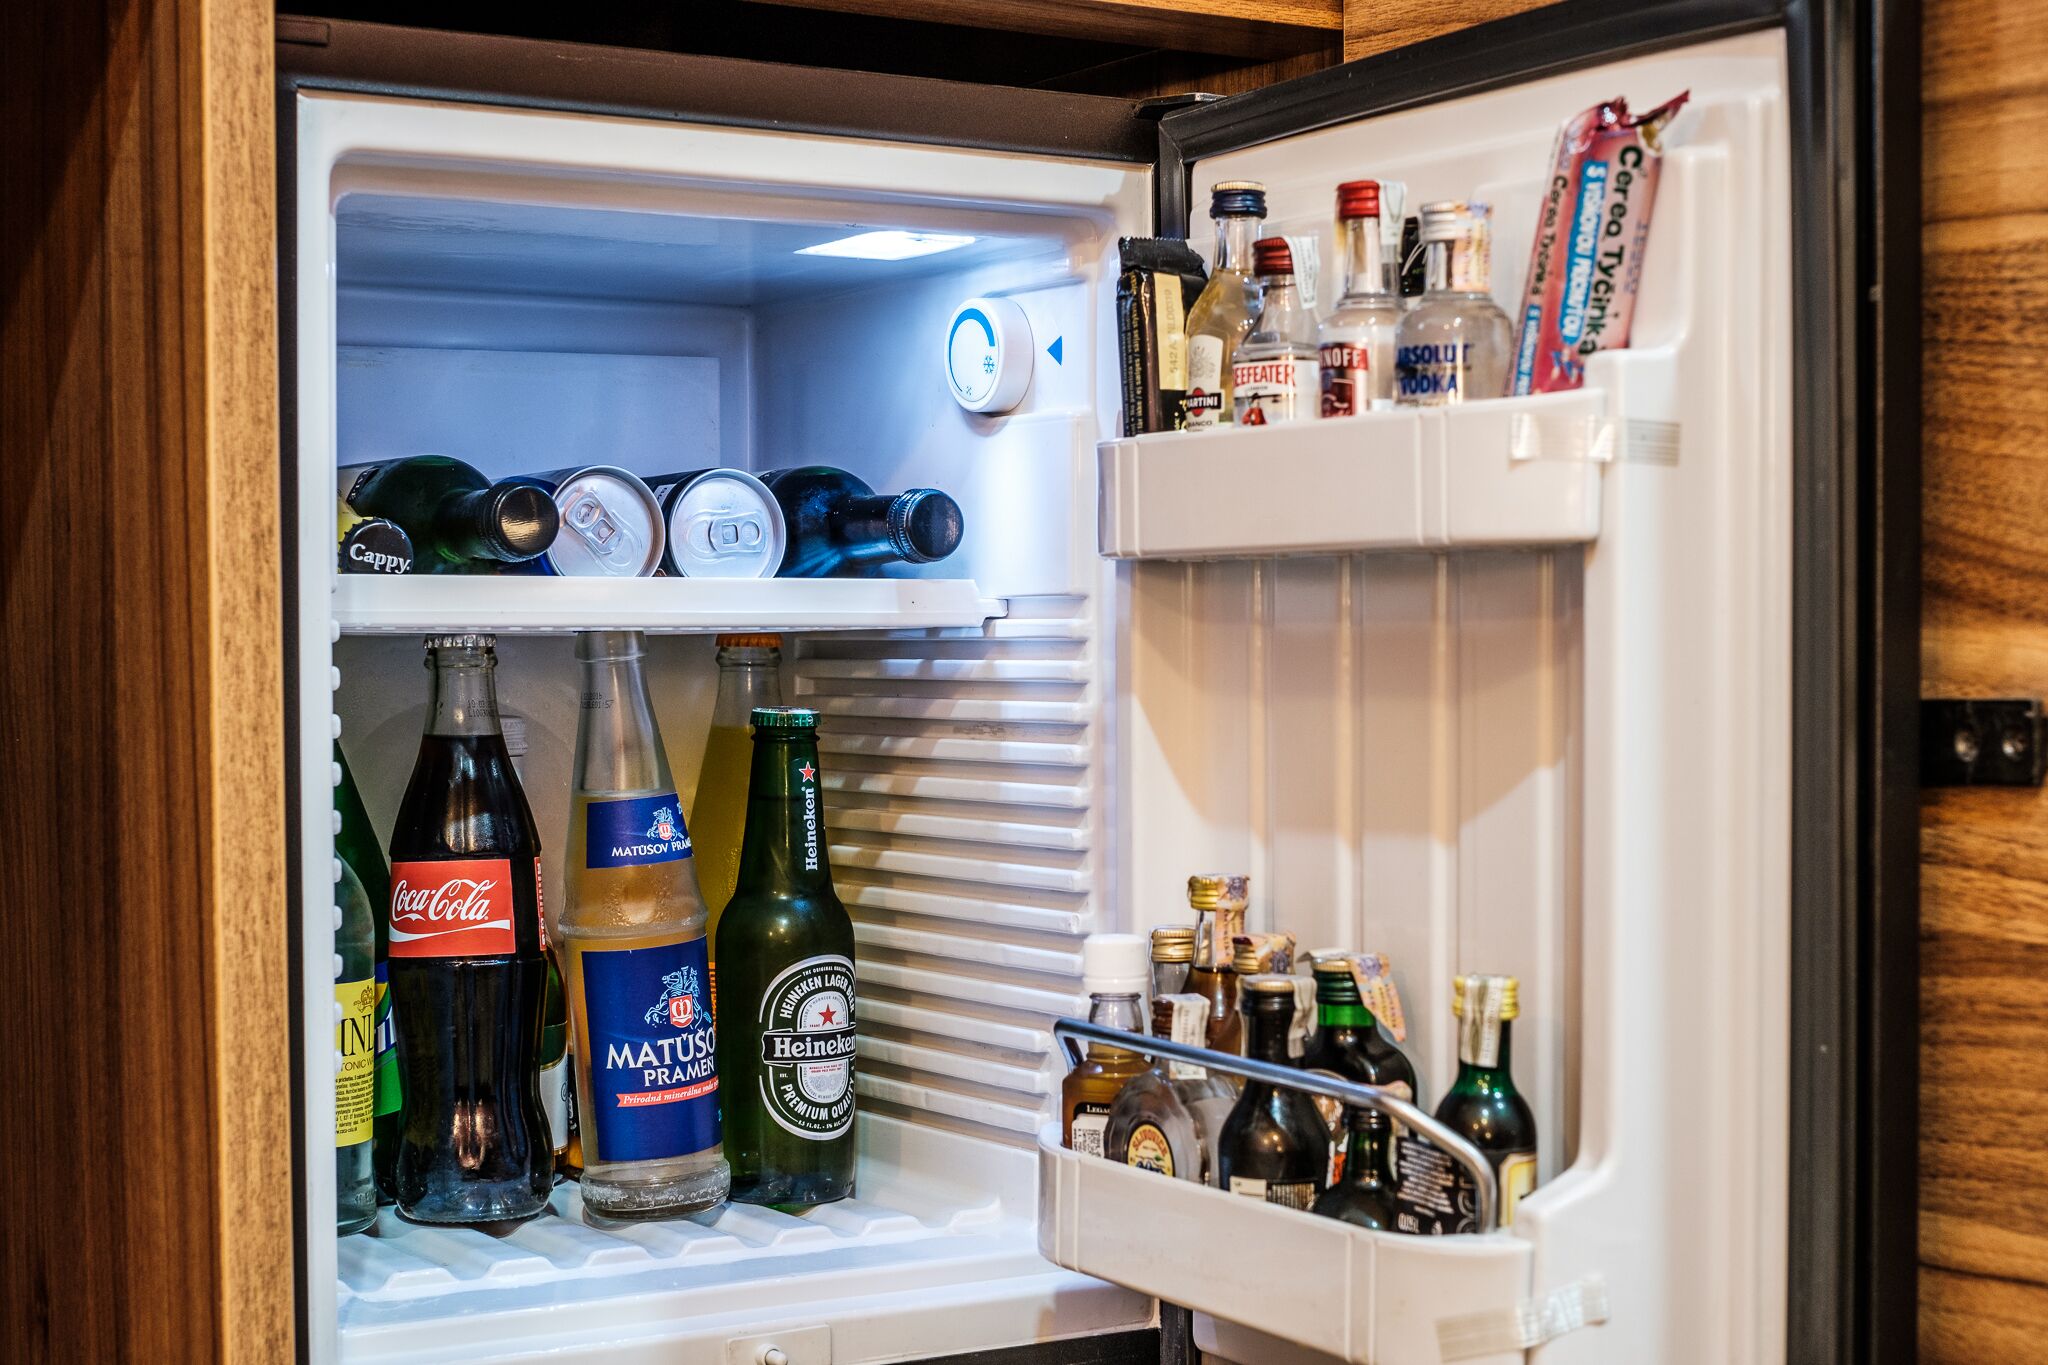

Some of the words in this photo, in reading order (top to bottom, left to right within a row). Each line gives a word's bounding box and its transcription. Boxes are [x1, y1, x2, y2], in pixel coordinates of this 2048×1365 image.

[1233, 364, 1296, 388] EEFEATER
[1319, 348, 1361, 369] NOFF
[803, 787, 818, 871] Heineken
[392, 879, 498, 922] Coca-Cola
[780, 975, 823, 1019] HEINEKEN
[825, 974, 849, 992] LAGER
[606, 1026, 716, 1070] MATÚŠO
[773, 1034, 856, 1058] Heineken
[624, 1093, 662, 1105] Prírodná
[781, 1083, 829, 1121] PREMIUM
[831, 1077, 855, 1119] QUALITY
